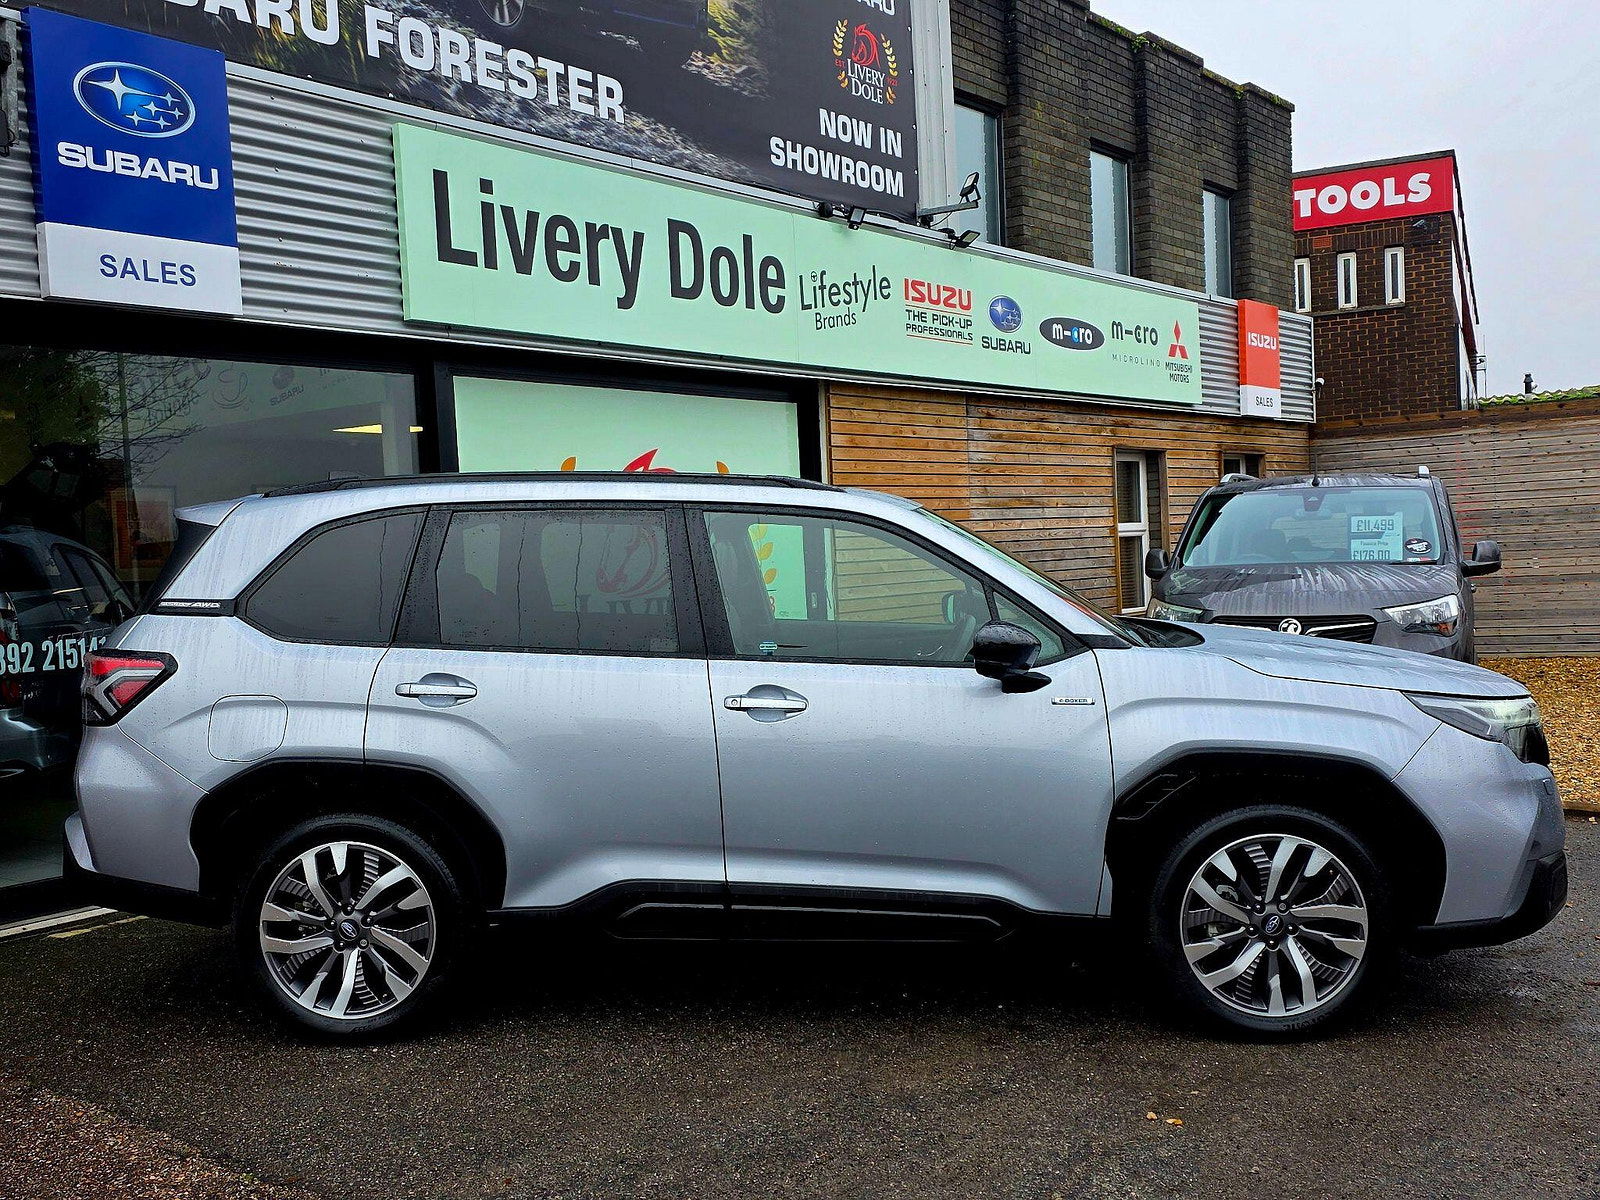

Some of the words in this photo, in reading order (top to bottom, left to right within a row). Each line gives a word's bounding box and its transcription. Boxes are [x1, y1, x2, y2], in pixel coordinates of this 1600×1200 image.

[365, 16, 625, 123] FORESTER
[847, 58, 885, 87] LIVERY
[851, 77, 884, 104] DOLE
[818, 108, 872, 149] NOW
[880, 126, 902, 158] IN
[56, 141, 219, 191] SUBARU
[769, 136, 905, 198] SHOWROOM
[1294, 172, 1432, 218] TOOLS
[432, 169, 645, 310] Livery
[667, 217, 786, 314] Dole
[99, 253, 197, 287] SALES
[799, 265, 891, 312] Lifestyle
[904, 277, 973, 311] ISUZU
[815, 307, 857, 330] Brands
[905, 309, 928, 324] THE
[932, 313, 973, 330] PICK-UP
[905, 323, 974, 341] PROFESSIONALS
[981, 336, 1031, 355] SUBARU
[1247, 332, 1277, 350] ISUZU
[1165, 361, 1193, 373] MITSUBISHI
[1169, 373, 1190, 383] MOTORS
[1255, 395, 1274, 408] SALES
[1356, 519, 1395, 532] £11,499
[1352, 549, 1391, 561] £176.00
